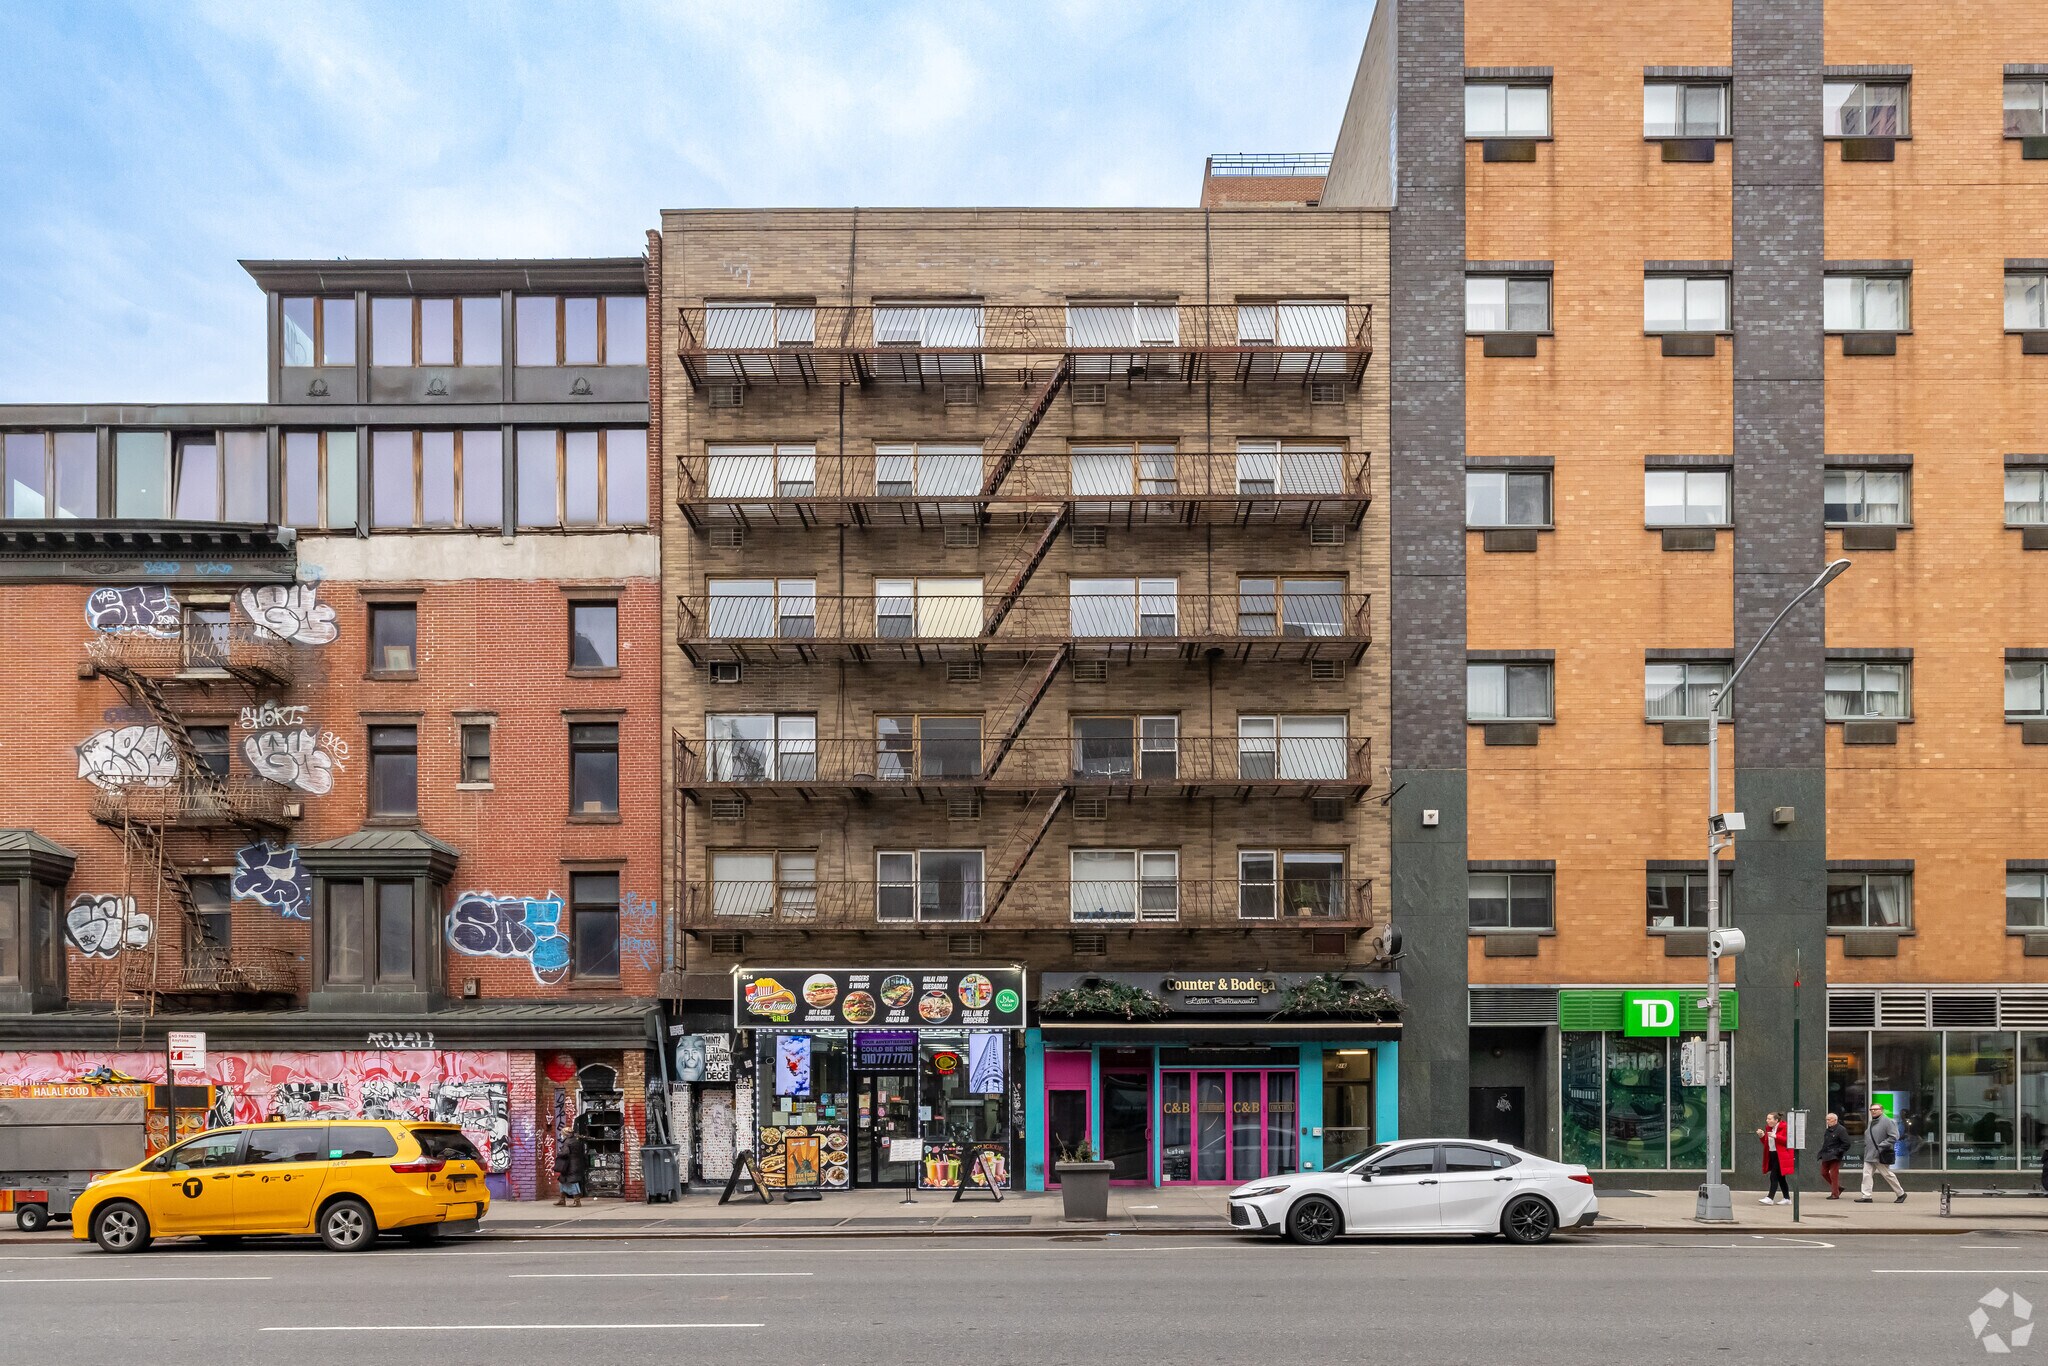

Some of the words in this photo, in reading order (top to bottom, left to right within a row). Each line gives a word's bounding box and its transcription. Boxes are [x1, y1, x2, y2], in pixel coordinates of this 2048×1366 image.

[1166, 978, 1215, 991] Counter
[1218, 978, 1228, 991] &
[1231, 978, 1276, 994] Bodega
[747, 1001, 762, 1011] 7th
[763, 1000, 798, 1011] Avenue
[1186, 996, 1210, 1005] Latin
[1212, 997, 1257, 1005] Restaurant
[961, 1009, 972, 1017] FULL
[972, 1009, 983, 1017] LINE
[983, 1009, 990, 1017] OF
[1632, 999, 1675, 1028] TD
[772, 1015, 790, 1023] GRILL
[962, 1016, 989, 1024] GROCERIES
[33, 1086, 63, 1097] HALAL
[64, 1086, 89, 1097] FOOD
[1164, 1102, 1190, 1114] C&B
[1233, 1102, 1260, 1113] C&B
[187, 1181, 198, 1196] T
